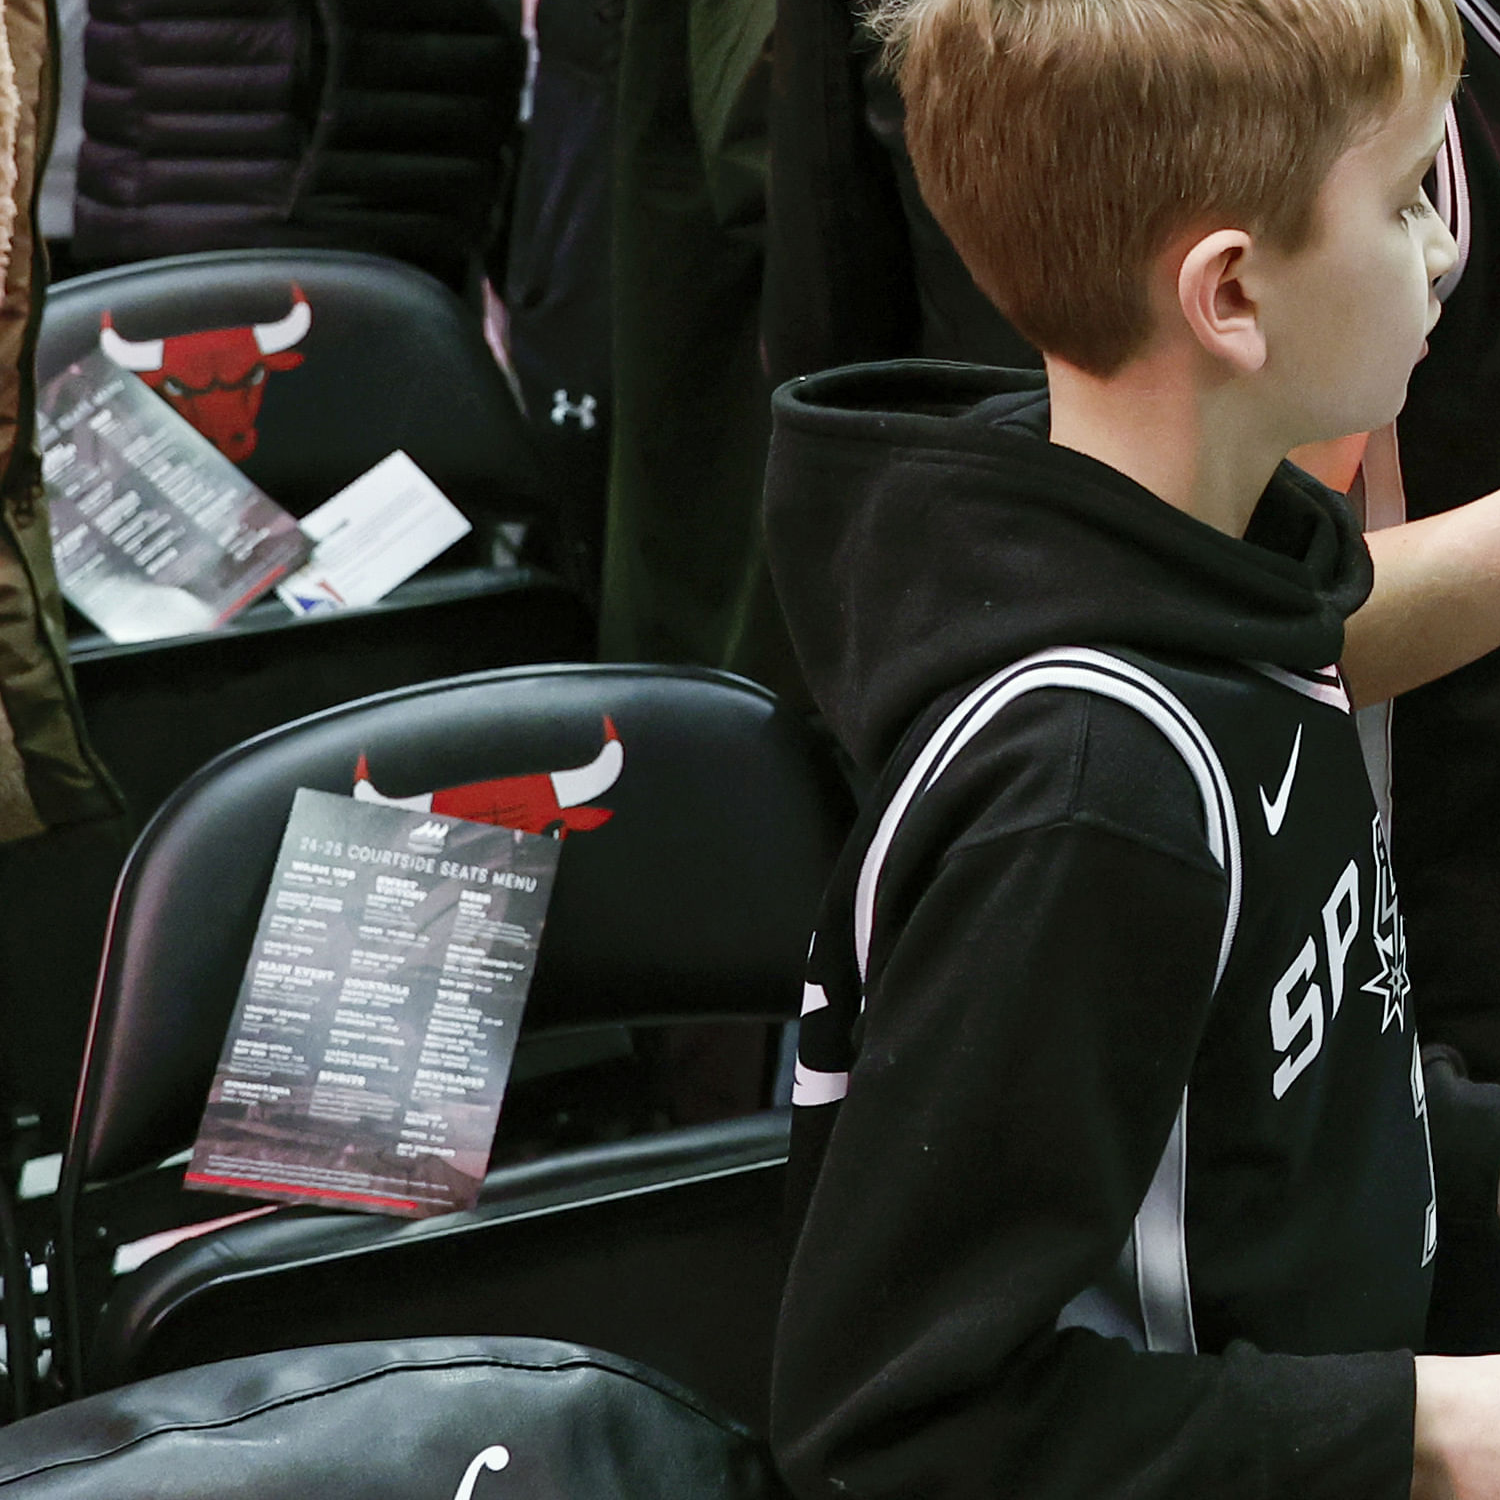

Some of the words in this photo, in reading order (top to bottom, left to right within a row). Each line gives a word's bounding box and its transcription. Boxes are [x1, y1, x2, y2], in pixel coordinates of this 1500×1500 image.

[347, 844, 435, 875] COURTSIDE
[439, 858, 489, 884] SEATS
[491, 870, 538, 894] MENU
